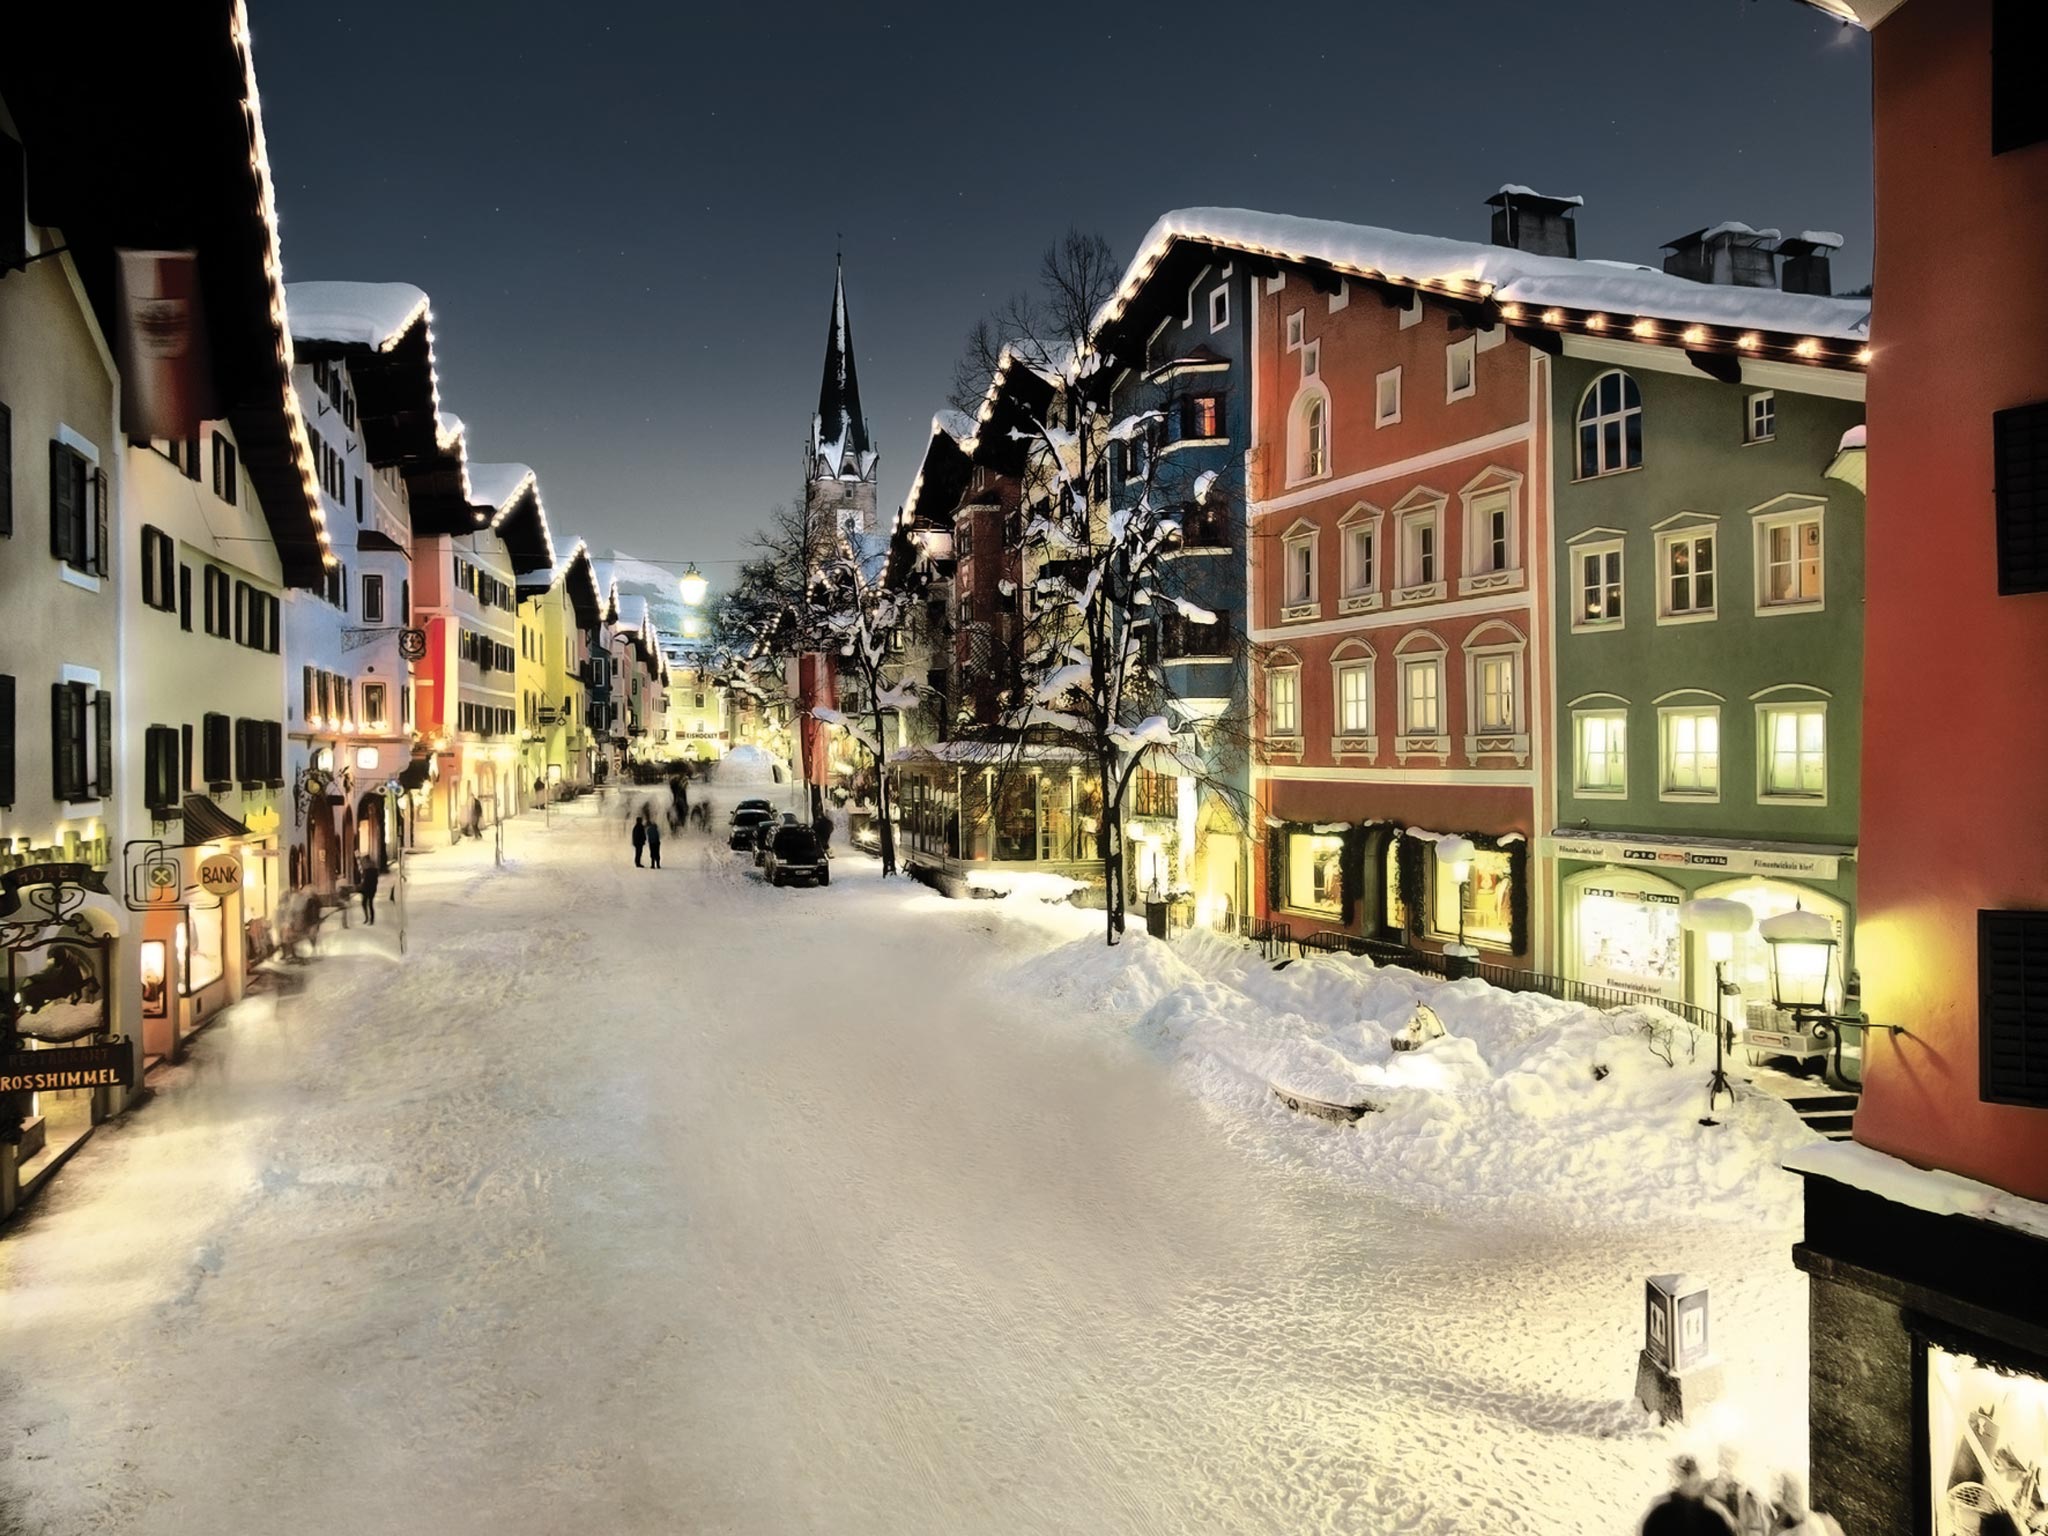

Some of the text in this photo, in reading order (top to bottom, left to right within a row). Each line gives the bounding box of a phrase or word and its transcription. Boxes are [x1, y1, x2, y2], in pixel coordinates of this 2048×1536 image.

[1625, 850, 1655, 859] Foto
[1692, 856, 1727, 865] Optik
[202, 865, 238, 885] BANK
[0, 1067, 121, 1092] ROSSHIMMEL
